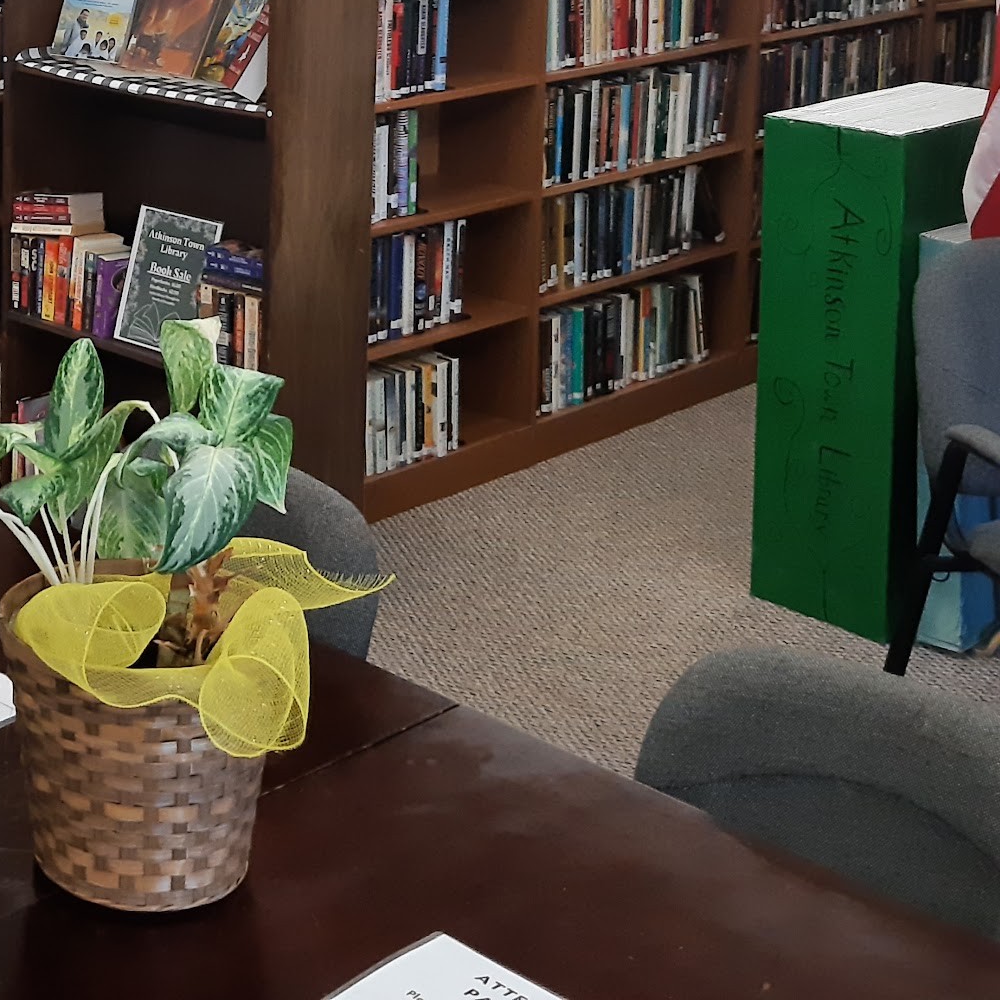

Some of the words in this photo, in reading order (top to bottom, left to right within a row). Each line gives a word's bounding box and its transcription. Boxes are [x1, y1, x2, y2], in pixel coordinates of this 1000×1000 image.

[149, 229, 182, 245] Atkinson
[183, 238, 205, 251] Town
[160, 244, 188, 261] Library
[150, 262, 172, 276] Book
[174, 268, 192, 282] Sale
[823, 198, 866, 342] Atkinson
[818, 358, 856, 424] Town
